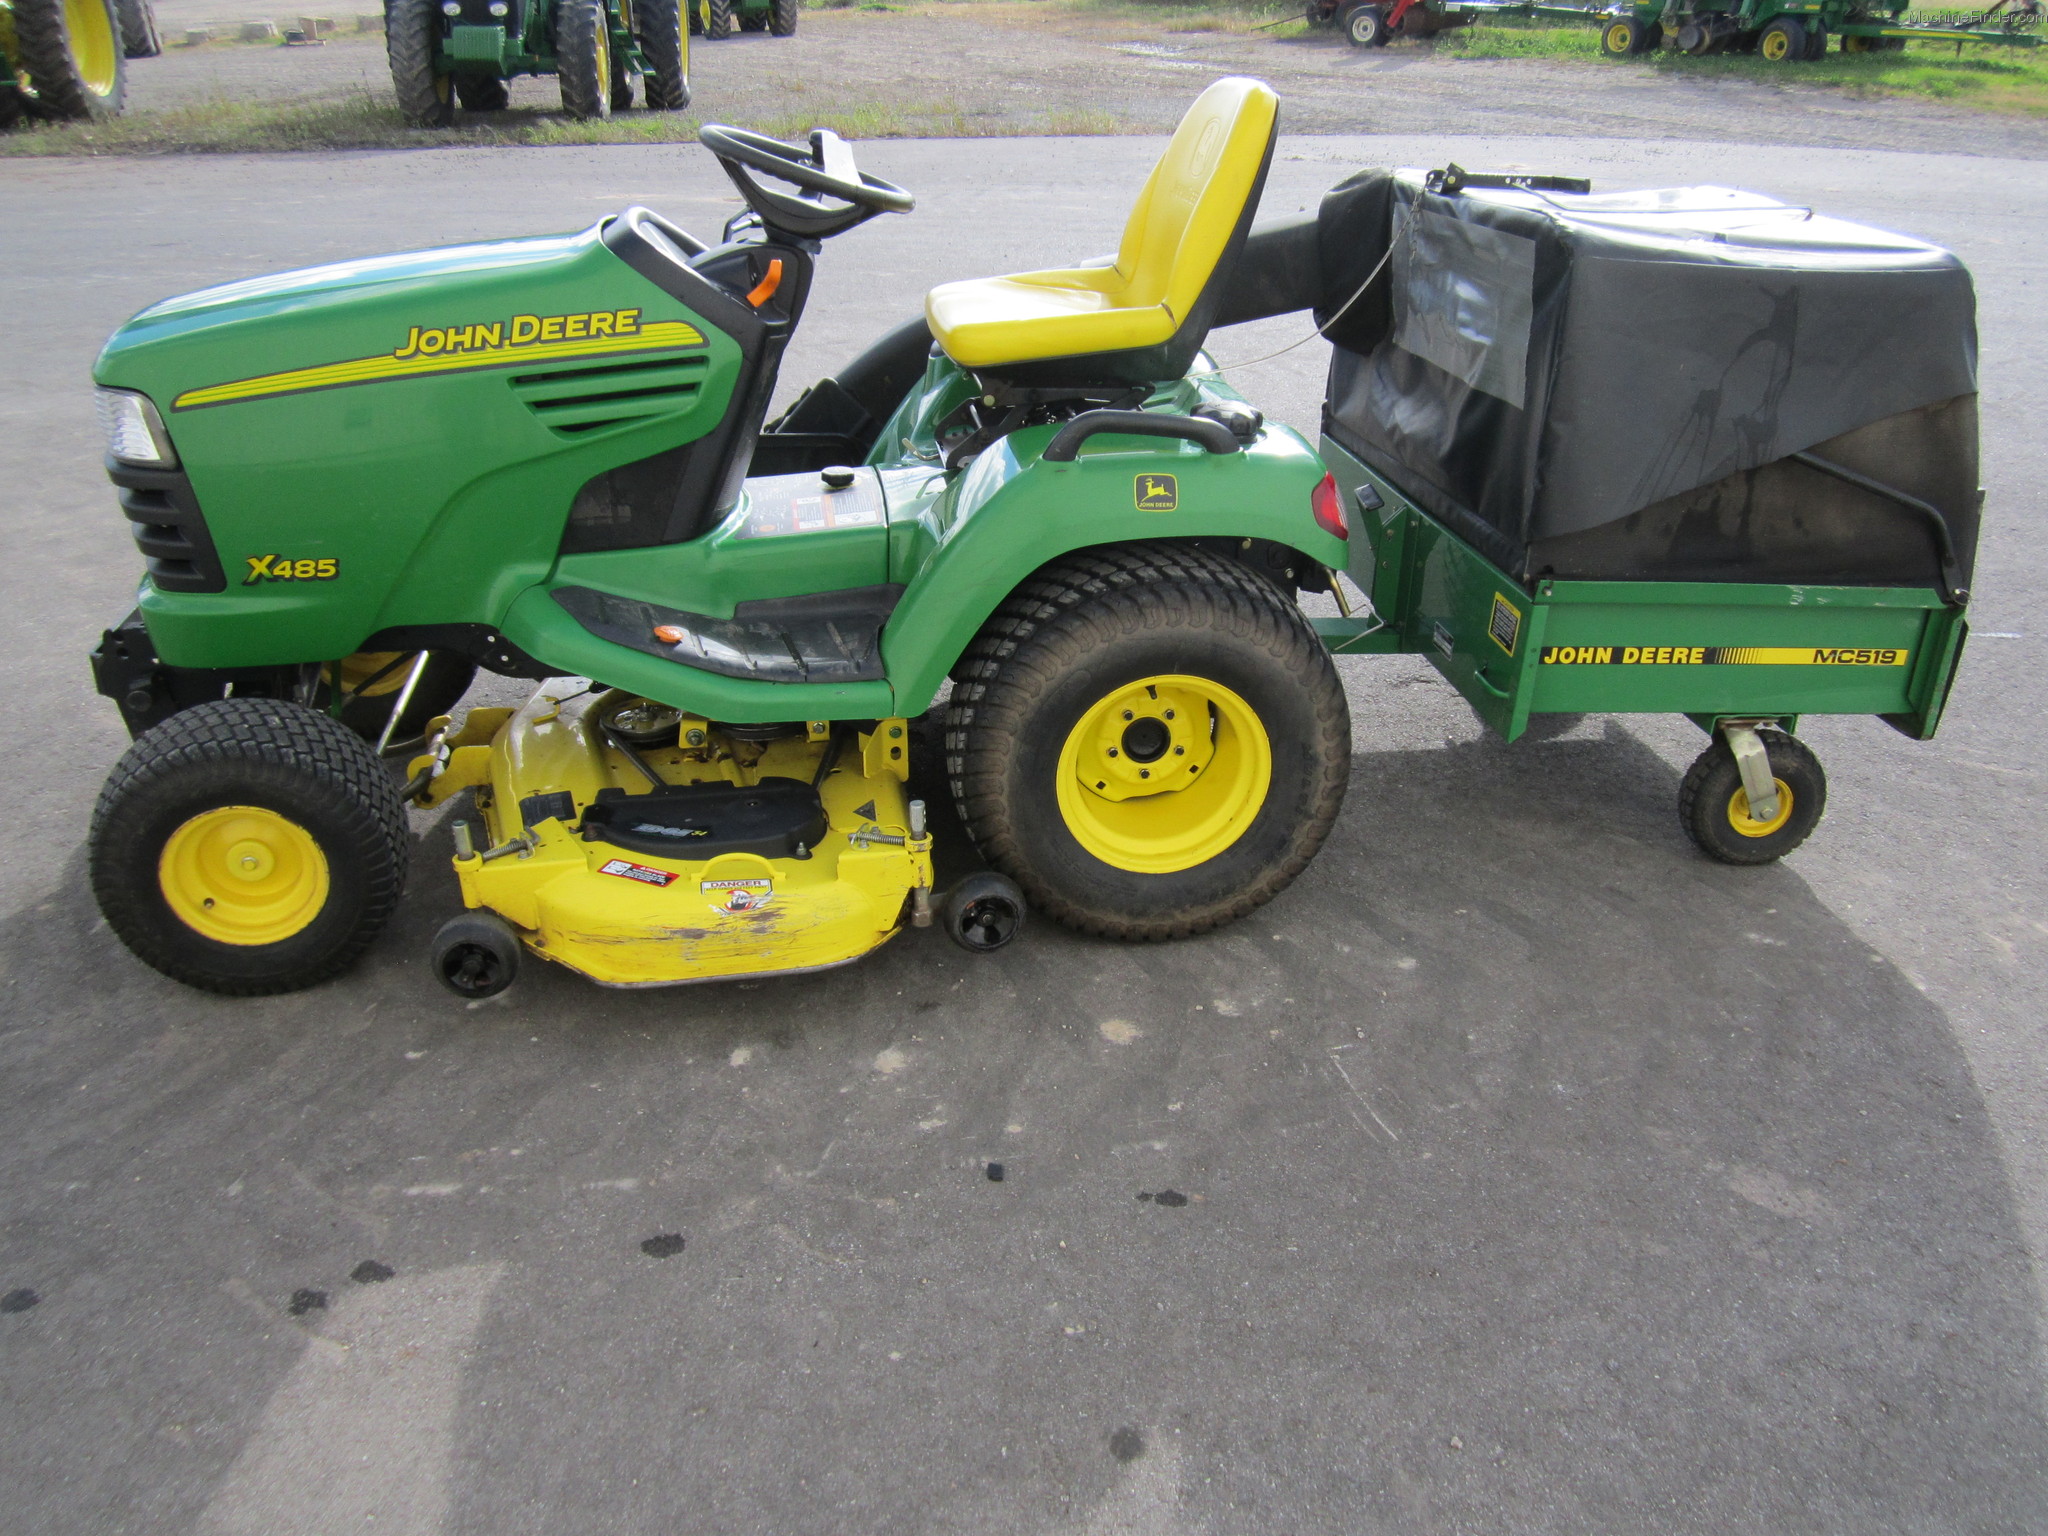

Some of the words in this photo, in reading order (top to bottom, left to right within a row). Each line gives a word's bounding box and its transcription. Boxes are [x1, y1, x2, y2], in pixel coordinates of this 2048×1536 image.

[394, 321, 504, 358] JOHN
[510, 309, 641, 346] DEERE
[244, 554, 337, 584] X485
[1543, 647, 1612, 665] JOHN
[1622, 647, 1705, 665] DEERE
[1813, 649, 1897, 664] MC519
